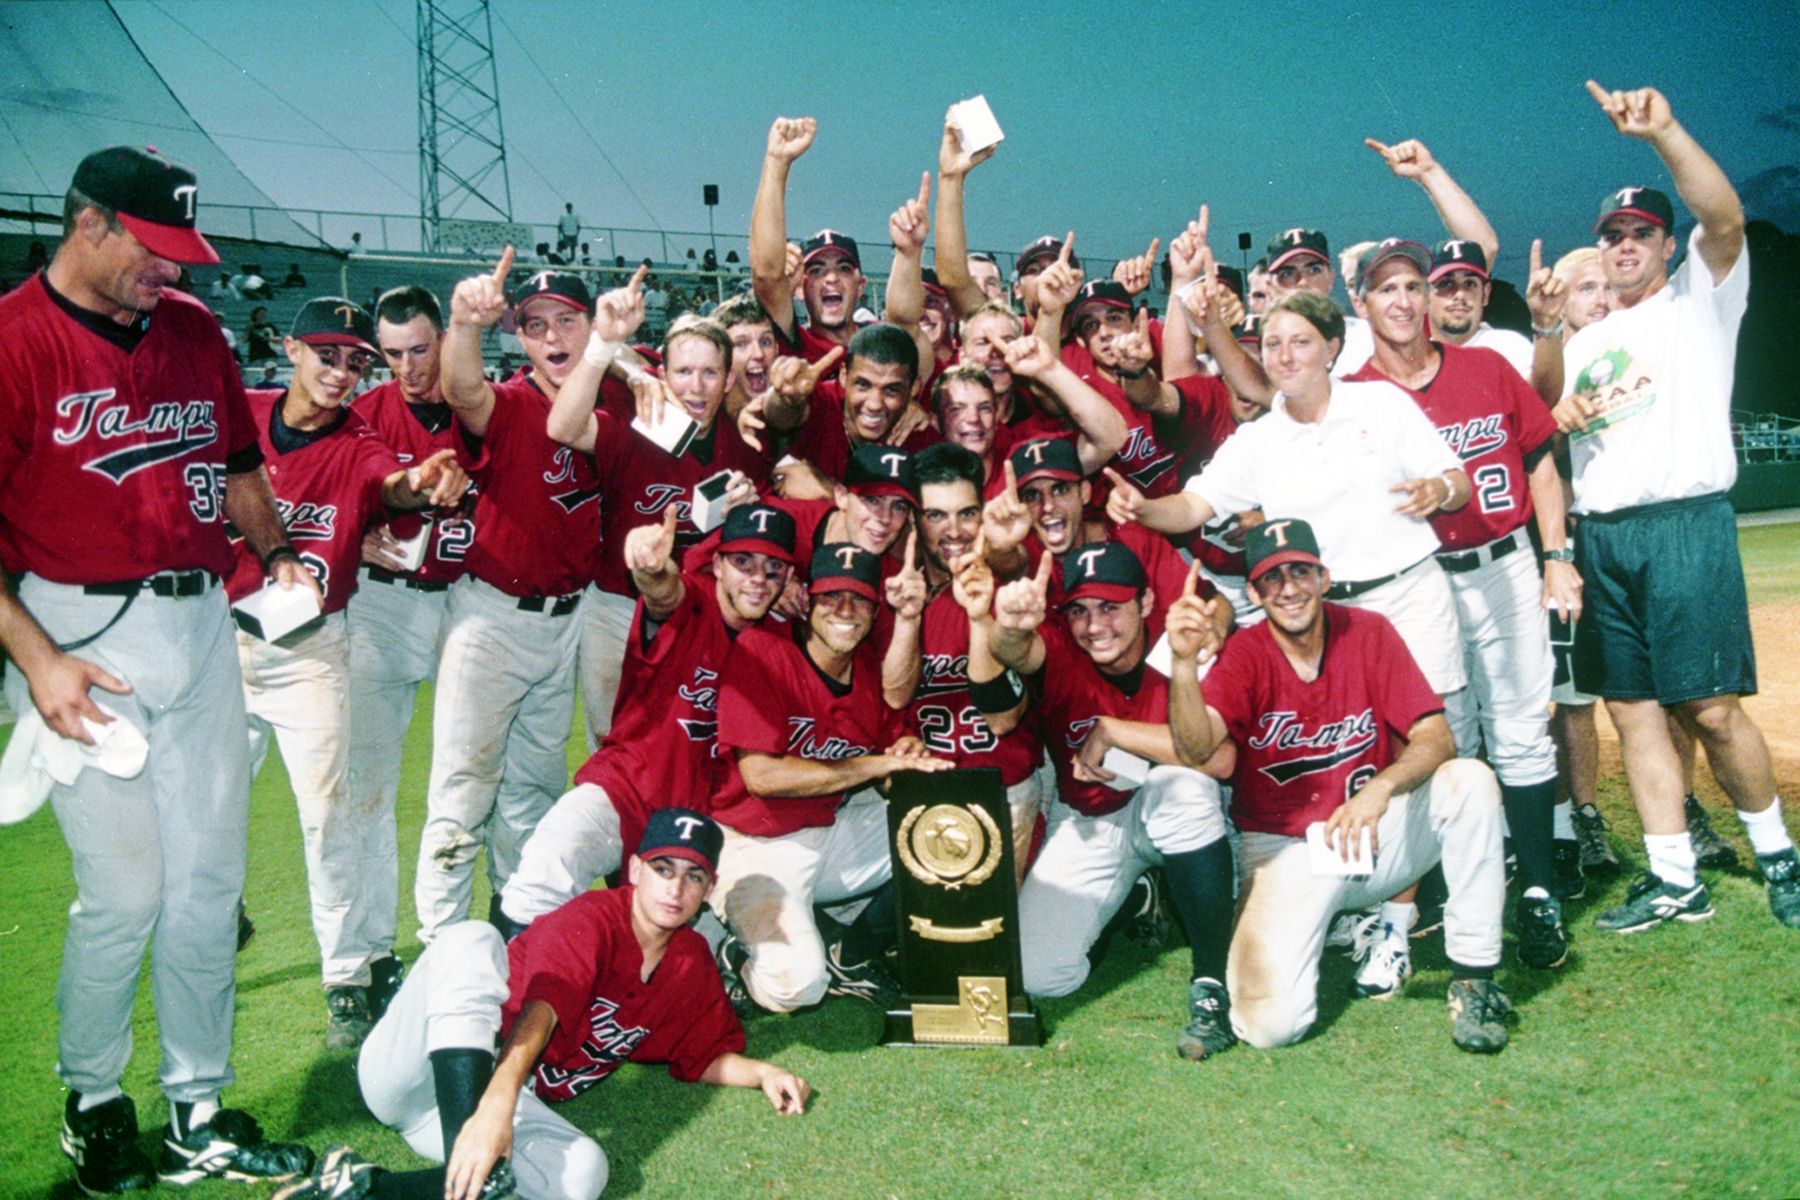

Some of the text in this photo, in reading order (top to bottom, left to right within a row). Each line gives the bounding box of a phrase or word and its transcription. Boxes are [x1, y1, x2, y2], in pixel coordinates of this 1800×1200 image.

[174, 185, 197, 219] T
[1616, 187, 1643, 206] T
[813, 228, 842, 245] T
[1284, 228, 1306, 245] T
[1443, 240, 1465, 259] T
[530, 270, 557, 291] T
[1080, 279, 1108, 297] T
[334, 306, 364, 328] T
[1239, 313, 1262, 331] T
[1024, 440, 1050, 465] T
[880, 453, 907, 477] T
[1474, 464, 1515, 514] 2
[749, 508, 777, 533] T
[1263, 520, 1292, 547] T
[834, 547, 863, 570] T
[1076, 548, 1107, 577] T
[917, 704, 999, 754] 23
[1249, 706, 1377, 754] Tampa
[674, 815, 704, 840] T
